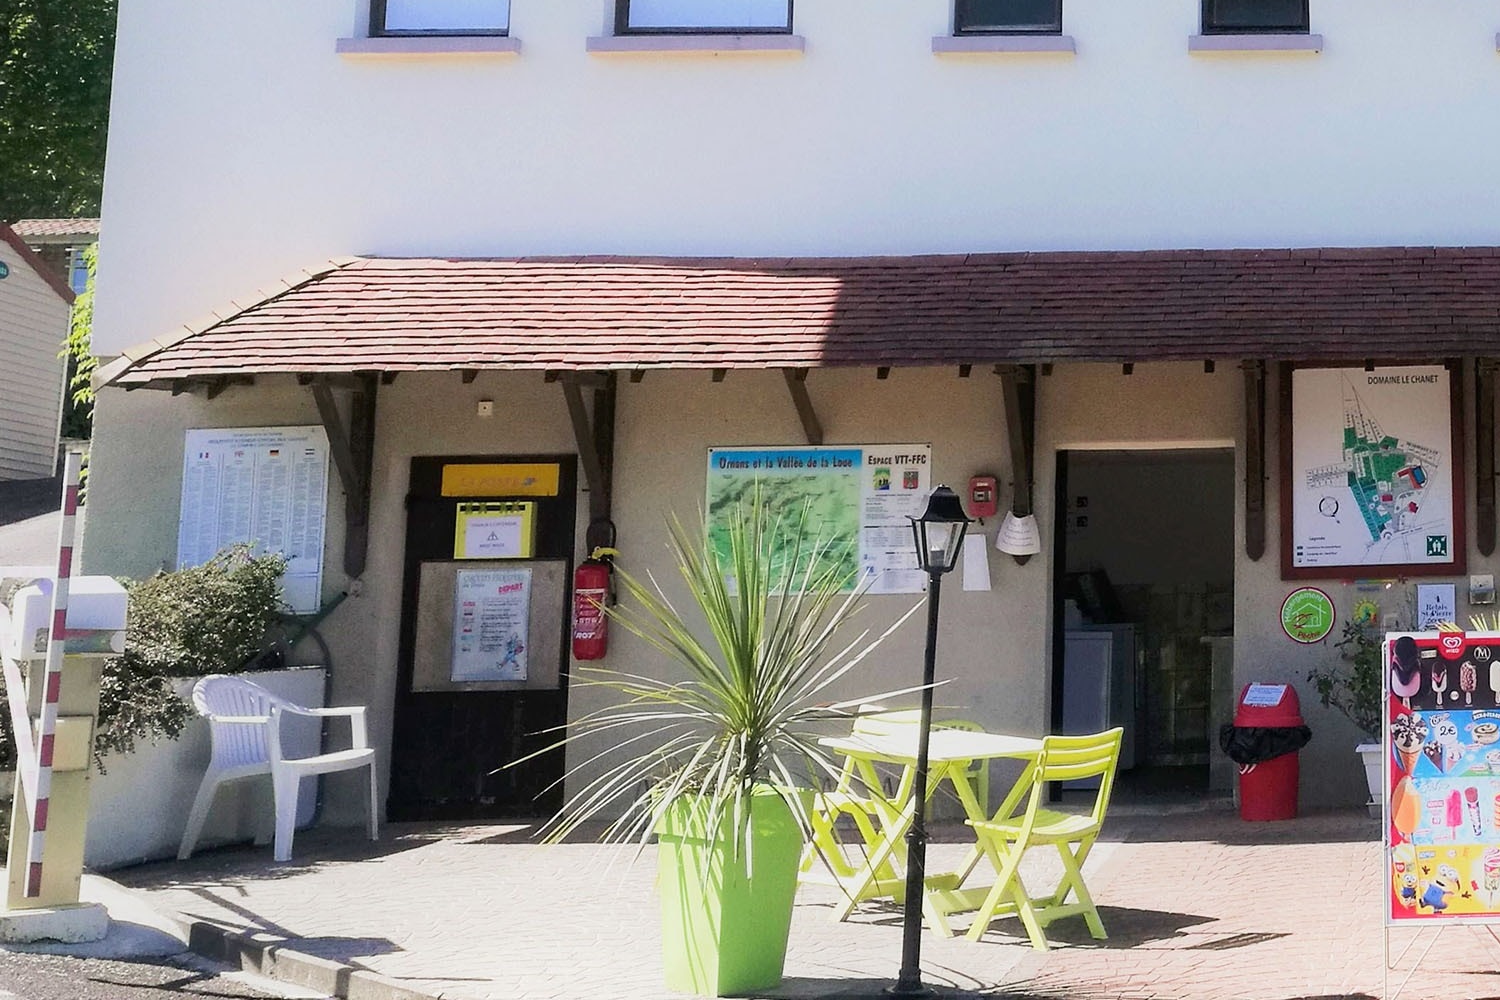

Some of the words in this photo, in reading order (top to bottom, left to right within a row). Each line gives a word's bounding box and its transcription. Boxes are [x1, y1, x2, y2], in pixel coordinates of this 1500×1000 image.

[1367, 376, 1400, 385] DOMAINE
[1402, 376, 1410, 384] LE
[1410, 375, 1439, 384] CHANET
[765, 456, 774, 468] la
[806, 455, 818, 468] de
[821, 455, 829, 467] la
[833, 454, 854, 468] Loue
[894, 454, 927, 465] VTT-FFC
[1440, 726, 1457, 736] 2€
